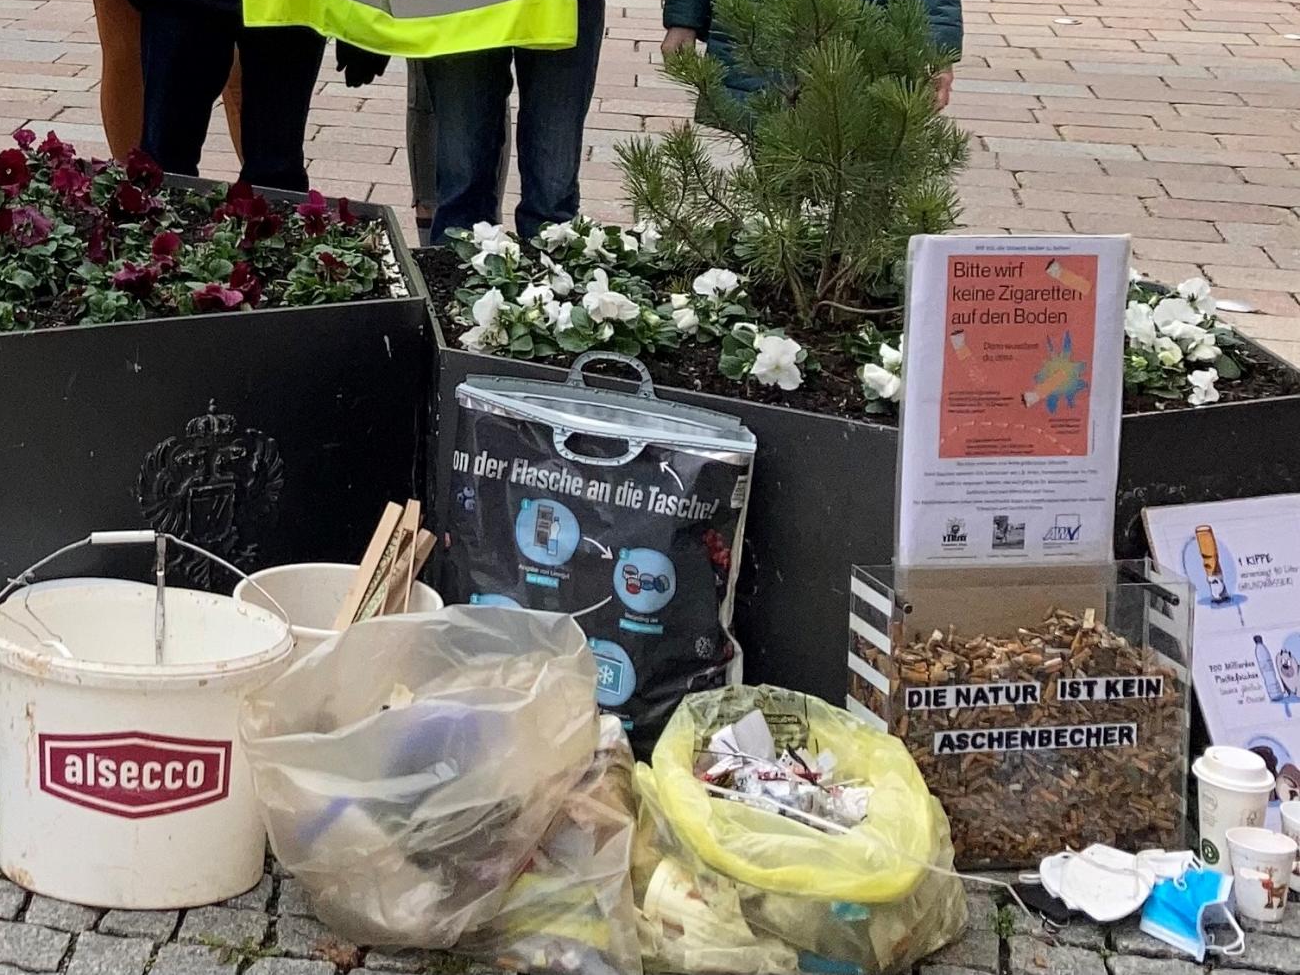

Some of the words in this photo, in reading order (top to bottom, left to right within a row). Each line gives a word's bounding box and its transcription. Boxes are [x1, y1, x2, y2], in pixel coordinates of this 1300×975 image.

[953, 262, 991, 278] Bitte
[993, 261, 1025, 278] wirf
[952, 284, 995, 302] keine
[998, 285, 1083, 305] Zigaretten
[951, 308, 977, 325] auf
[979, 309, 1011, 325] den
[1014, 307, 1068, 325] Boden
[473, 450, 508, 480] der
[510, 458, 583, 497] Flasche
[586, 480, 611, 503] an
[615, 479, 644, 510] die
[648, 486, 720, 521] Tasche!
[907, 688, 947, 709] DIE
[955, 684, 1039, 707] NATUR
[1059, 680, 1098, 700] IST
[1104, 678, 1163, 700] KEIN
[937, 725, 1135, 753] ASCHENBECHER
[64, 752, 206, 790] alsecco
